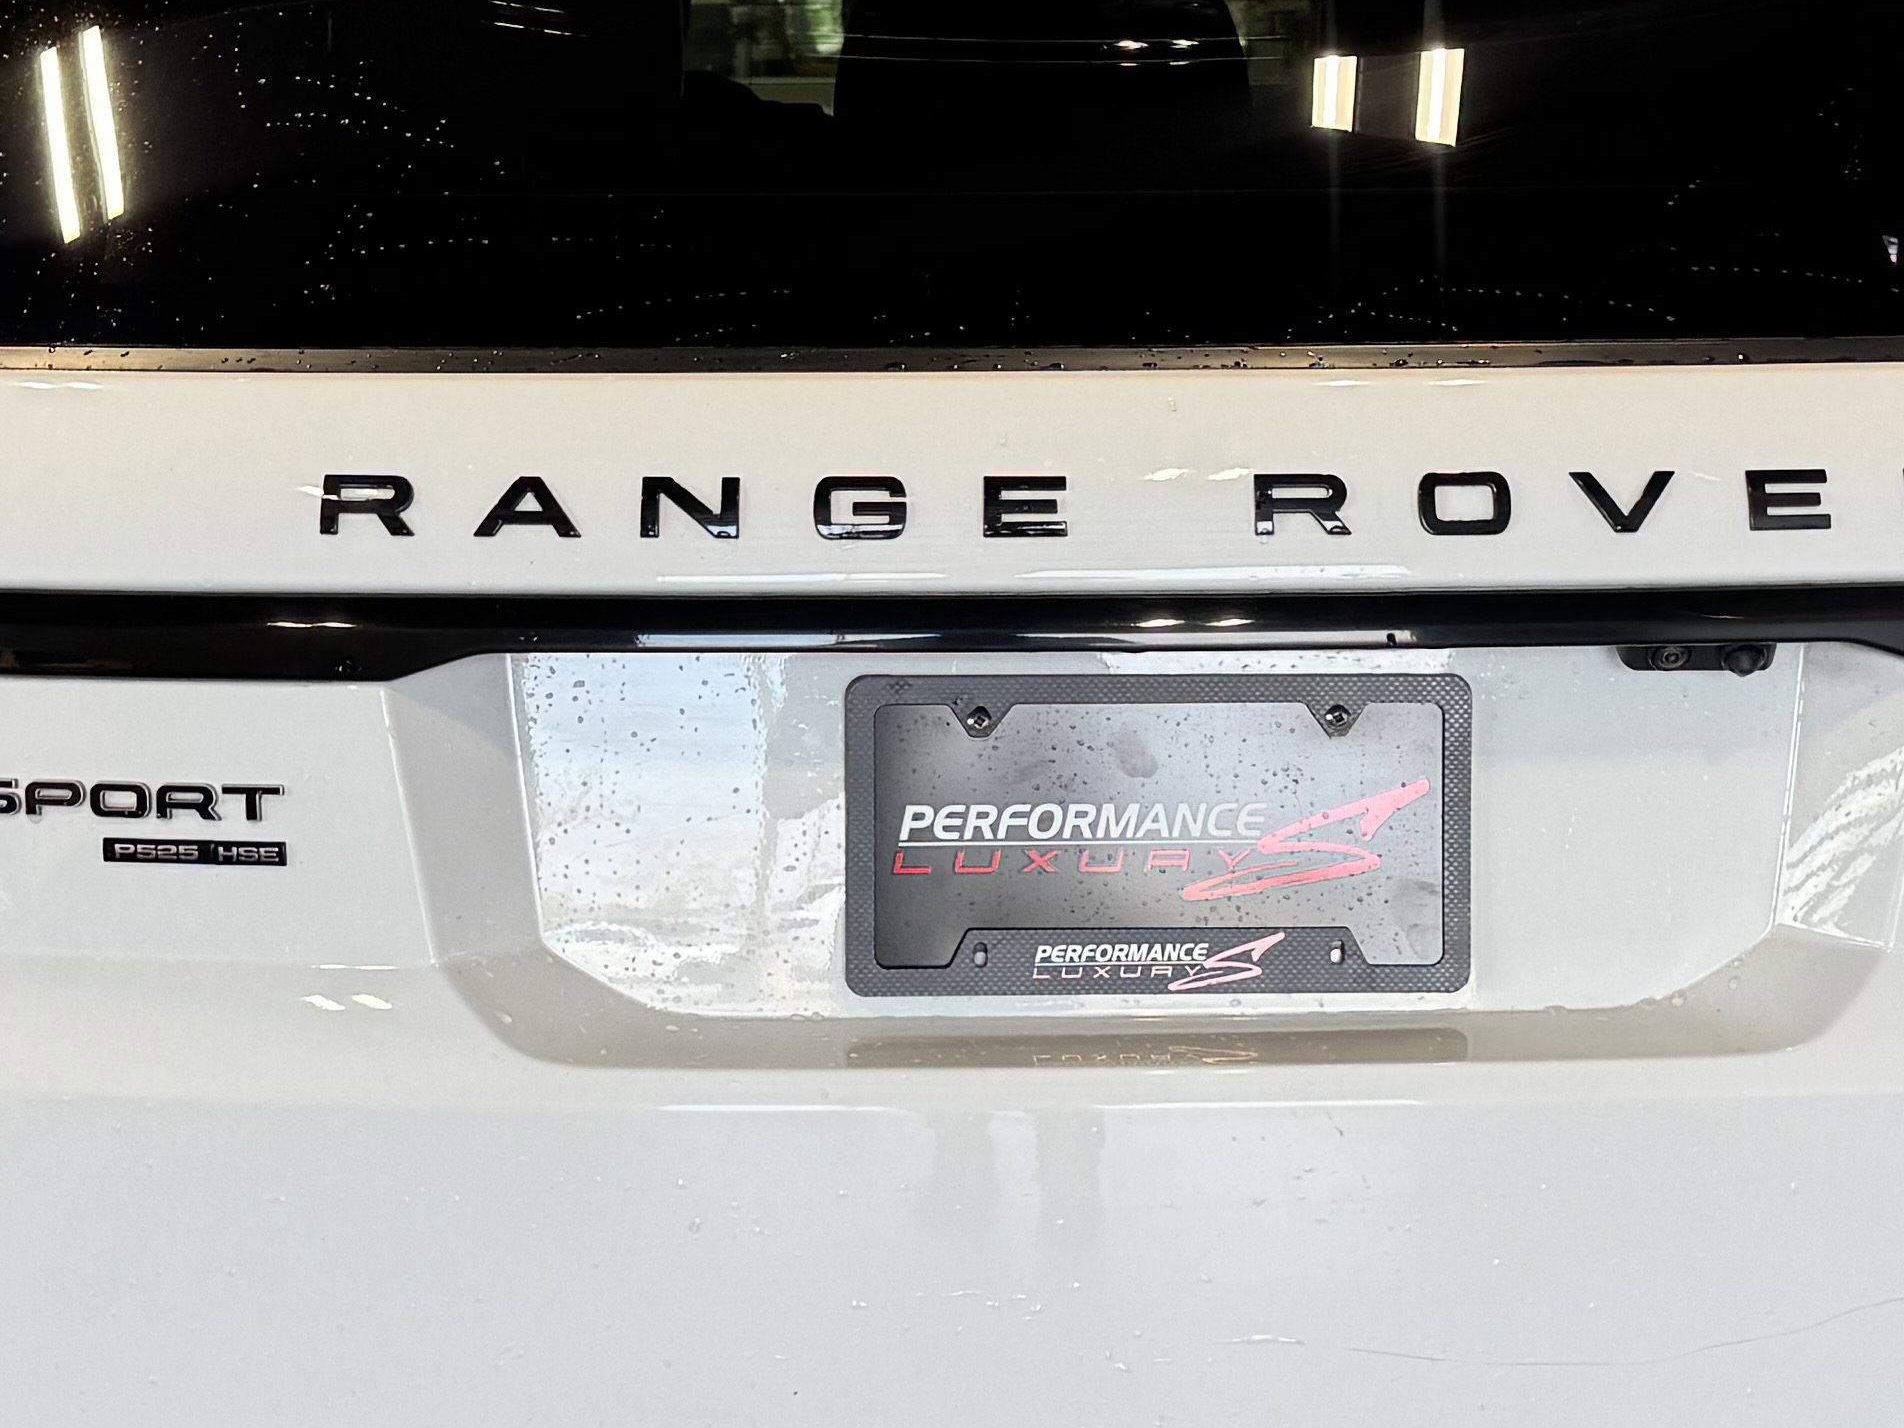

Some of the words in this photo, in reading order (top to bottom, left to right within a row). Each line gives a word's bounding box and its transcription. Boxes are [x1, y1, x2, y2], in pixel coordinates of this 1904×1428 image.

[318, 473, 1071, 542] RANGE
[898, 802, 1268, 840] PERFORMANCE
[113, 843, 200, 861] P525
[217, 846, 280, 863] HSE
[892, 848, 1253, 875] LUXURY
[1034, 942, 1210, 963] PERFORMANCE
[1032, 965, 1202, 980] LUXURY
